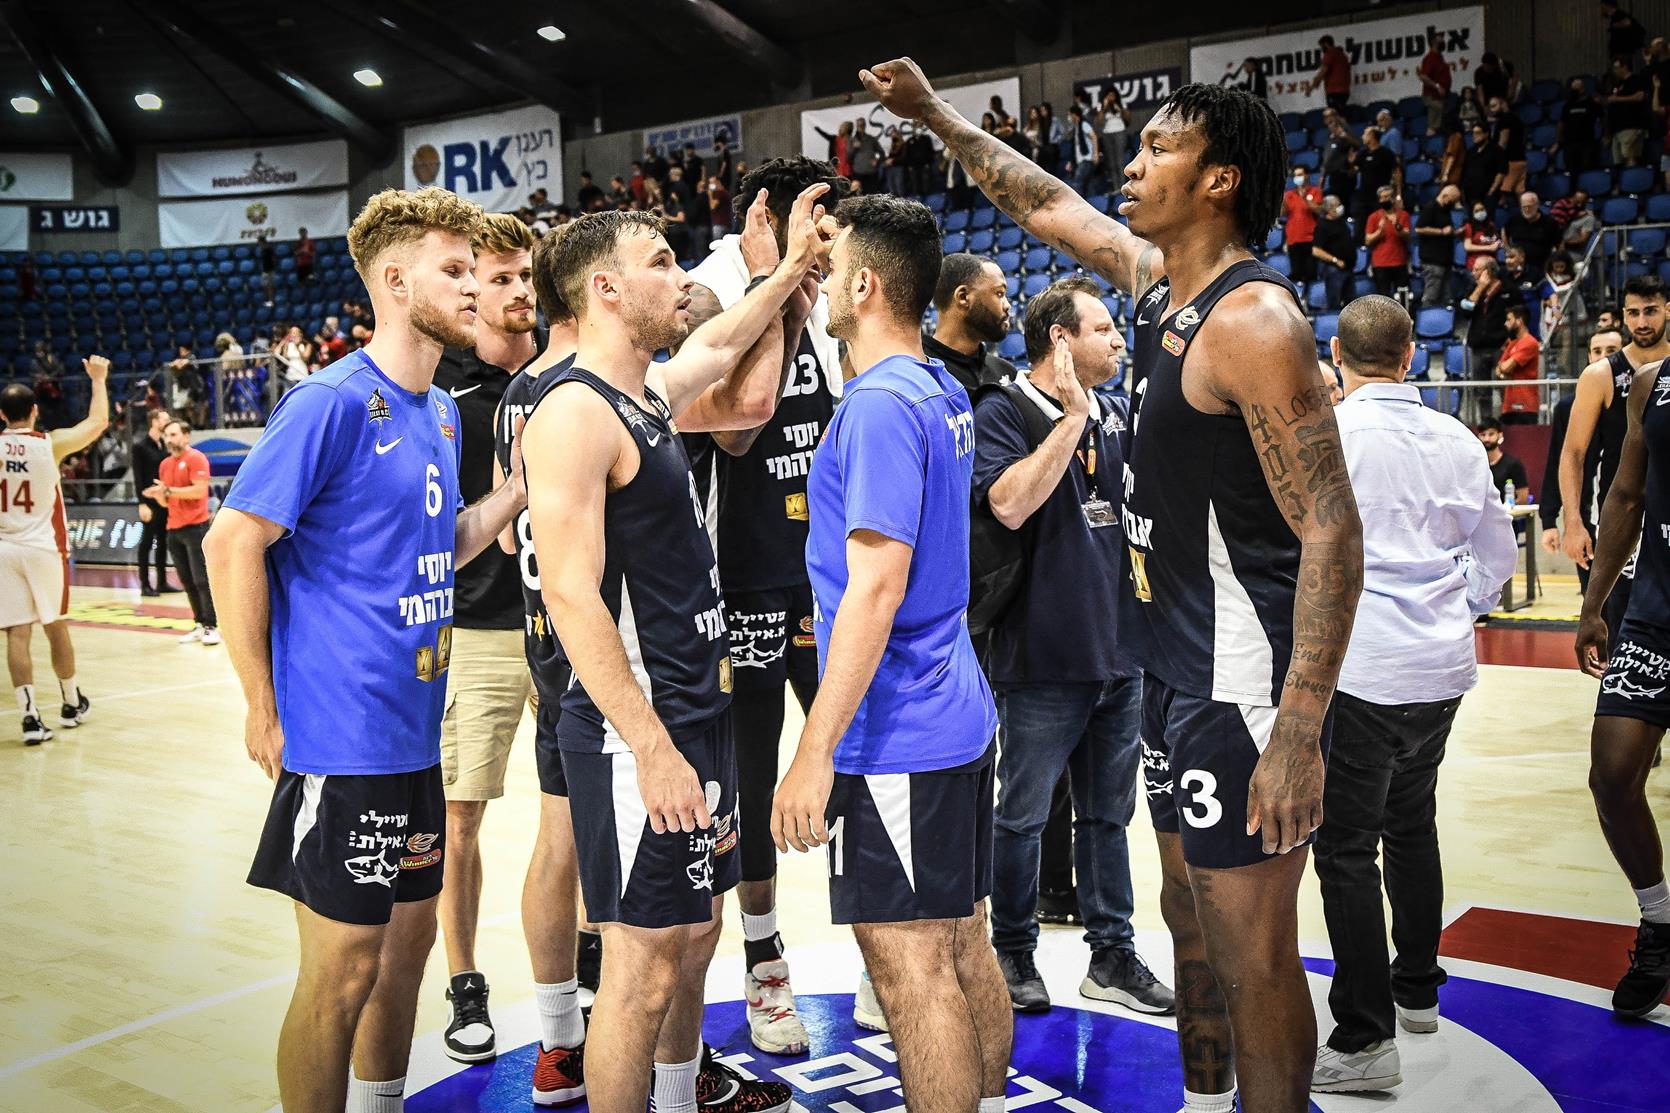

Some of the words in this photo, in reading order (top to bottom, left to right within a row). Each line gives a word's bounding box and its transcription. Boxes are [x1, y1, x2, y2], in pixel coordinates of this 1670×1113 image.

[1114, 74, 1170, 109] גוש
[513, 127, 554, 157] רענן
[444, 134, 518, 193] RK
[521, 160, 548, 187] כץ
[40, 210, 53, 228] ג
[62, 210, 110, 229] גוש
[782, 353, 819, 398] 23
[783, 420, 819, 448] יוסי
[6, 460, 29, 473] RK
[766, 450, 817, 480] רהמי
[0, 479, 34, 514] 14
[425, 463, 443, 518] 6
[517, 509, 541, 591] 8
[418, 551, 452, 585] יוסי
[398, 588, 453, 626] ברהמי
[1180, 769, 1223, 829] 3
